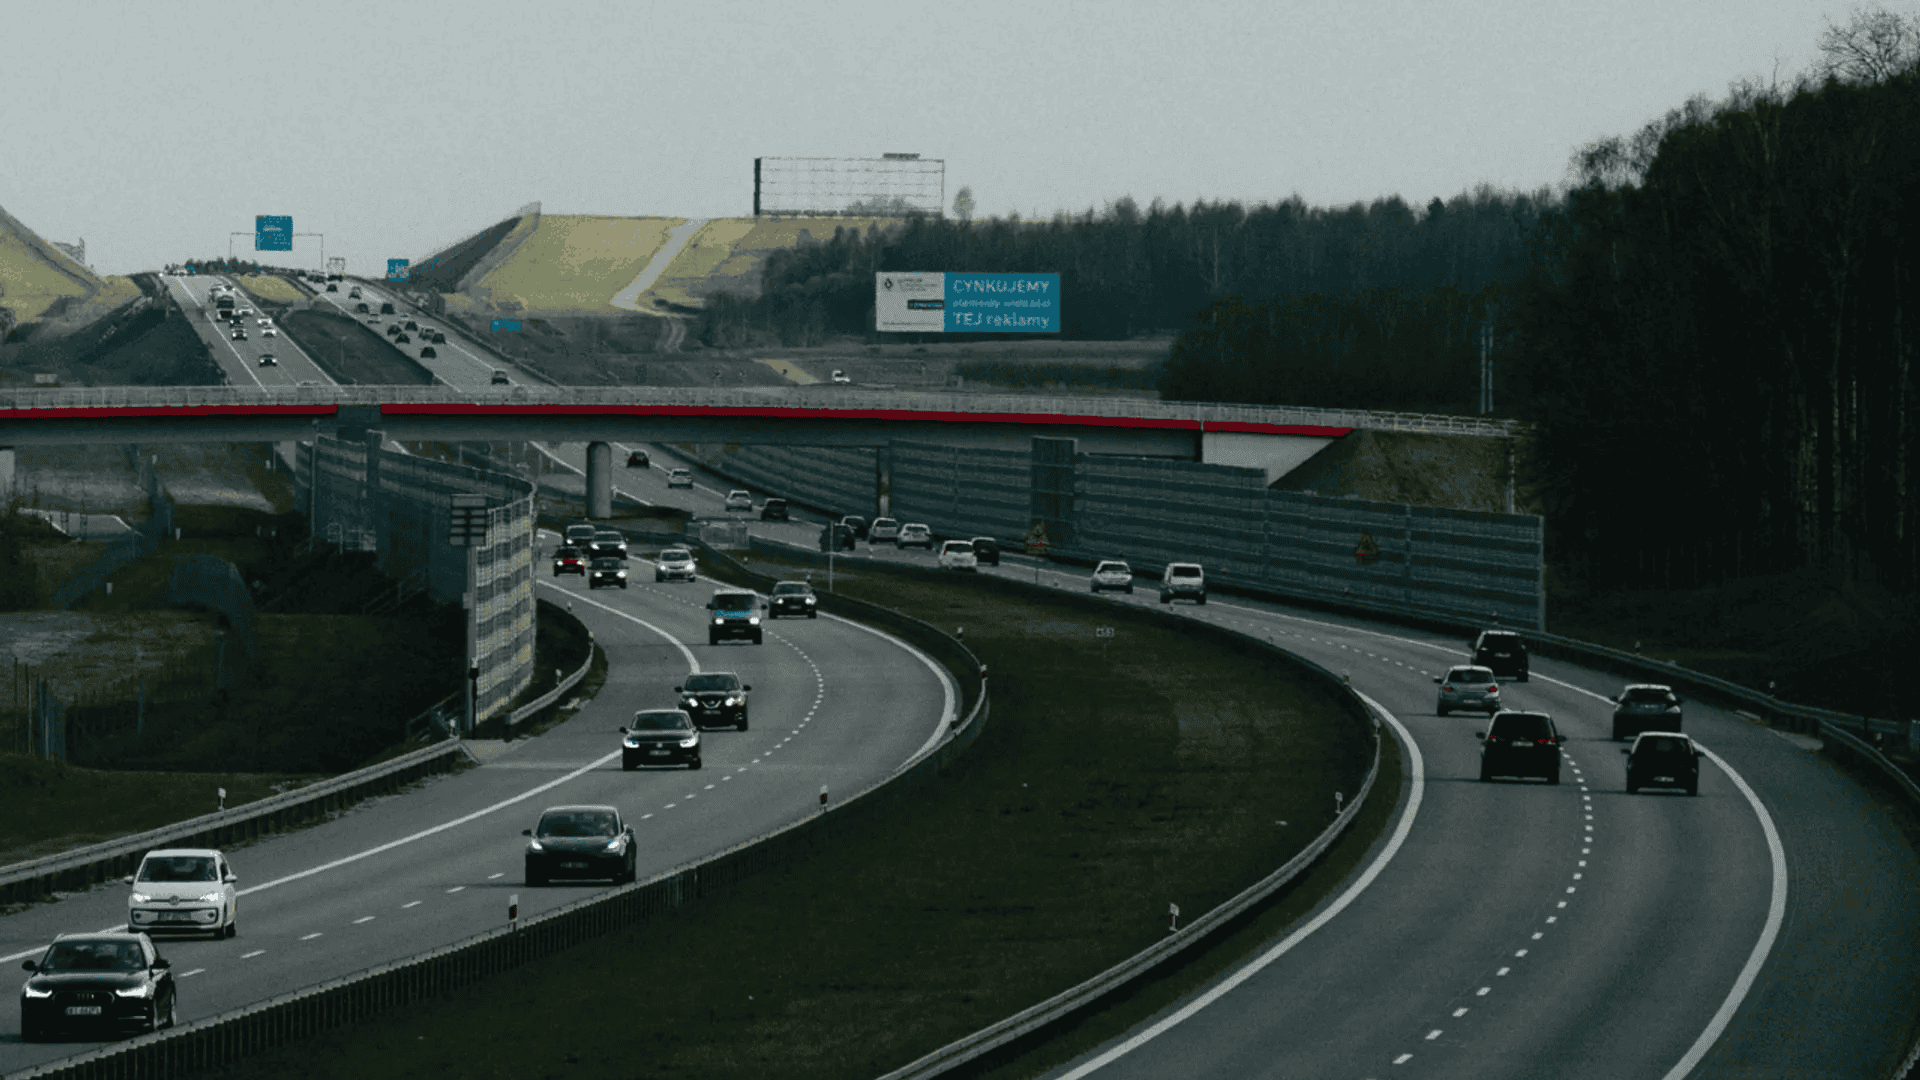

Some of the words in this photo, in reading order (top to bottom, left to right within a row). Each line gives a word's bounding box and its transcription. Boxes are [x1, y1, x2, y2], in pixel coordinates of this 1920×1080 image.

[953, 279, 1050, 293] CYNKUJEMY
[953, 312, 982, 326] TEJ
[986, 312, 1050, 329] reklamy
